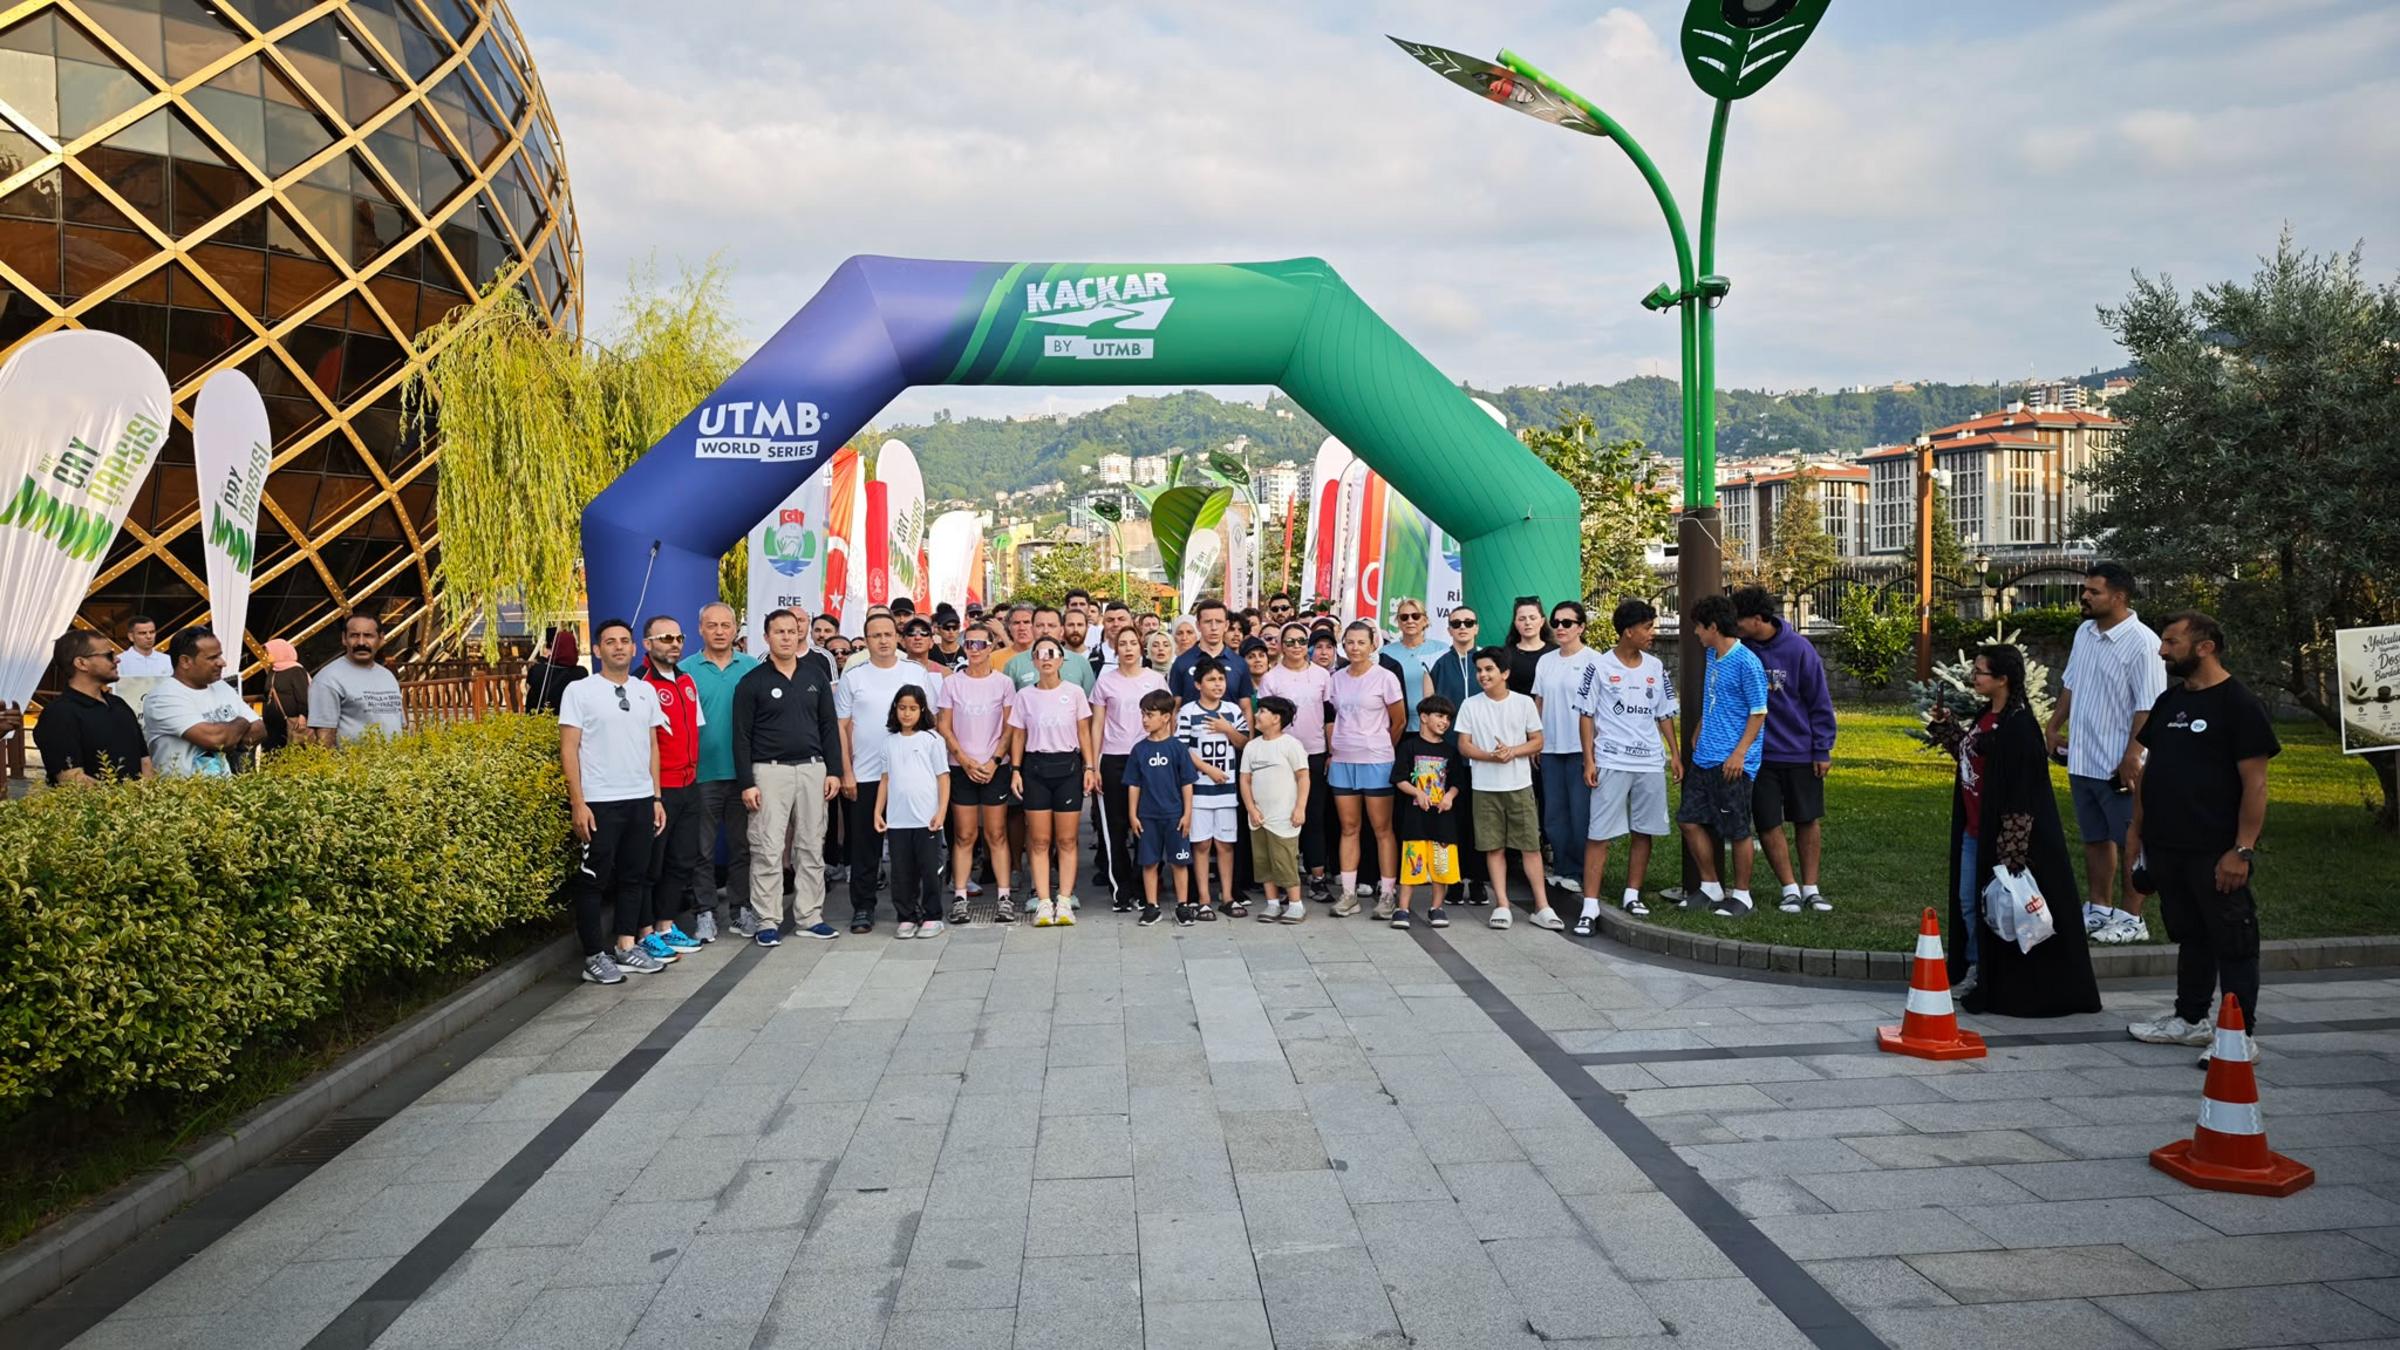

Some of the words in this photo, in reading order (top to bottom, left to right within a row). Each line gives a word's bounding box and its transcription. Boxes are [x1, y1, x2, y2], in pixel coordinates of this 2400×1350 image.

[1026, 272, 1169, 313] KAÇKAR
[1054, 340, 1072, 352] BY
[1093, 343, 1141, 356] UTMB
[702, 442, 760, 454] WORLD
[767, 445, 813, 458] SERIES
[1447, 589, 1461, 602] Rİ
[1149, 752, 1168, 767] alo
[1176, 848, 1190, 860] alo
